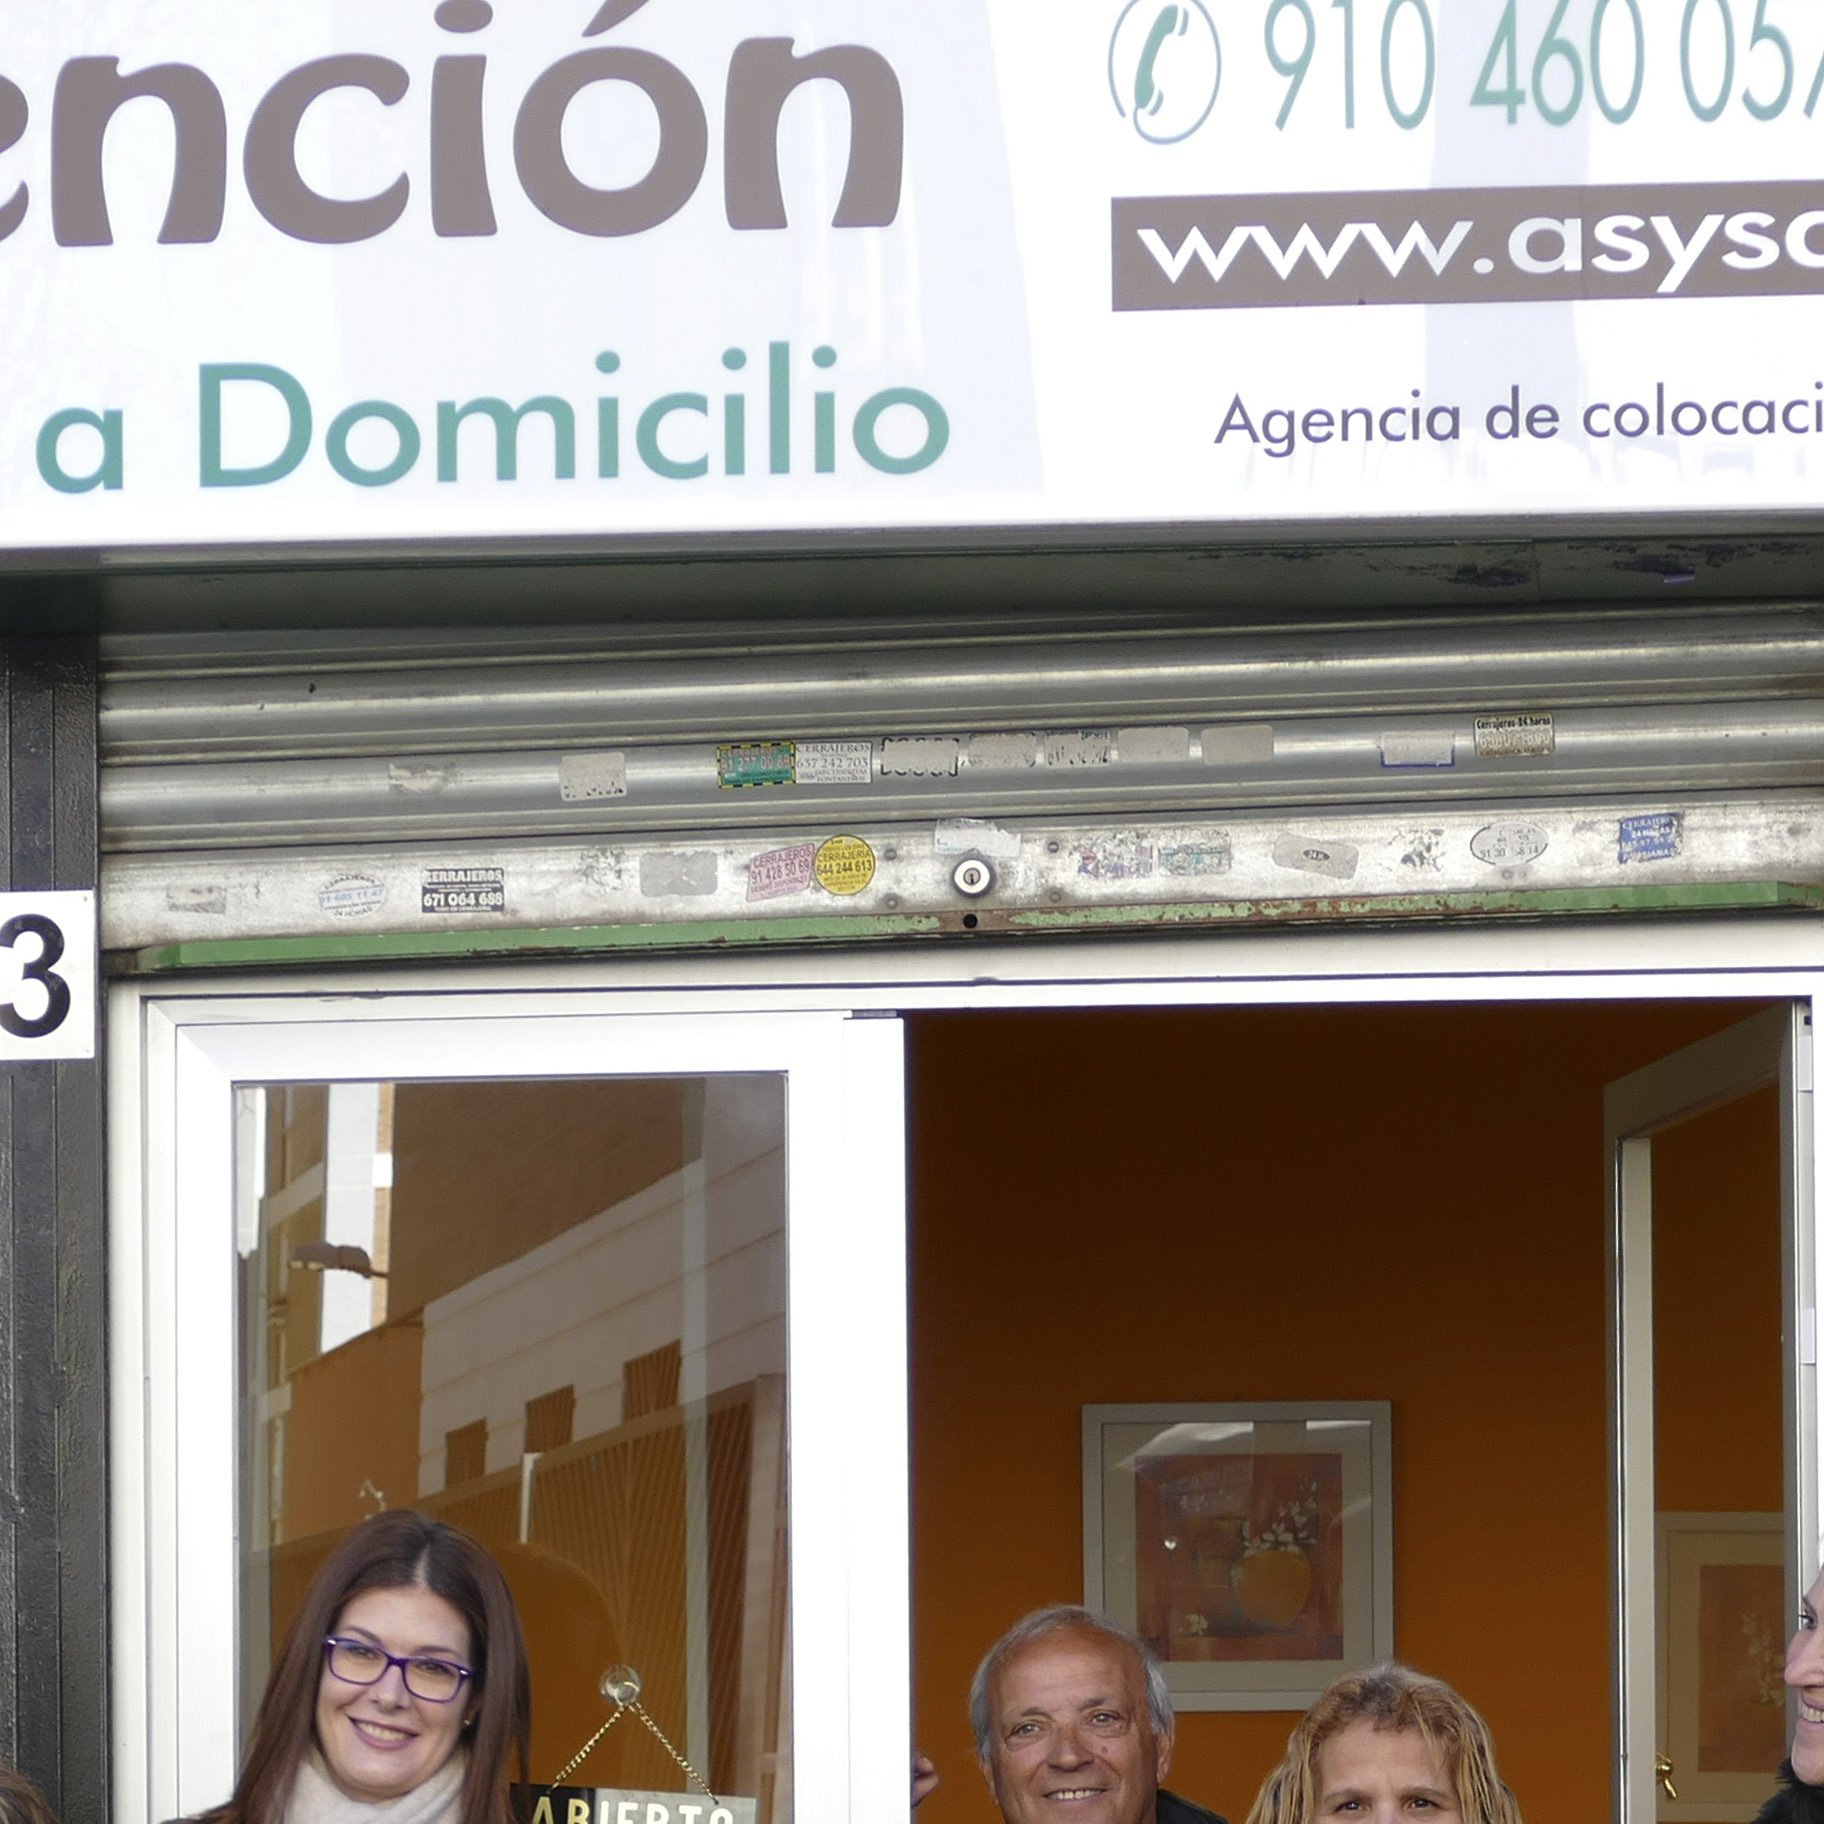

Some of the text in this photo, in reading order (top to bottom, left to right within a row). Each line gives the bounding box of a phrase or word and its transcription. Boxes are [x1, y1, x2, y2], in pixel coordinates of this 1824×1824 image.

[1265, 0, 1434, 130] 910
[1470, 0, 1644, 127] 460
[37, 409, 122, 493] a
[200, 343, 949, 487] Domicilio
[1215, 390, 1459, 457] Agencia
[1486, 385, 1559, 439] de
[796, 743, 869, 753] CERRAJEROS
[753, 846, 812, 868] CERRAJEROS
[423, 893, 445, 907] 671
[448, 892, 476, 906] 064
[0, 915, 70, 1037] 3
